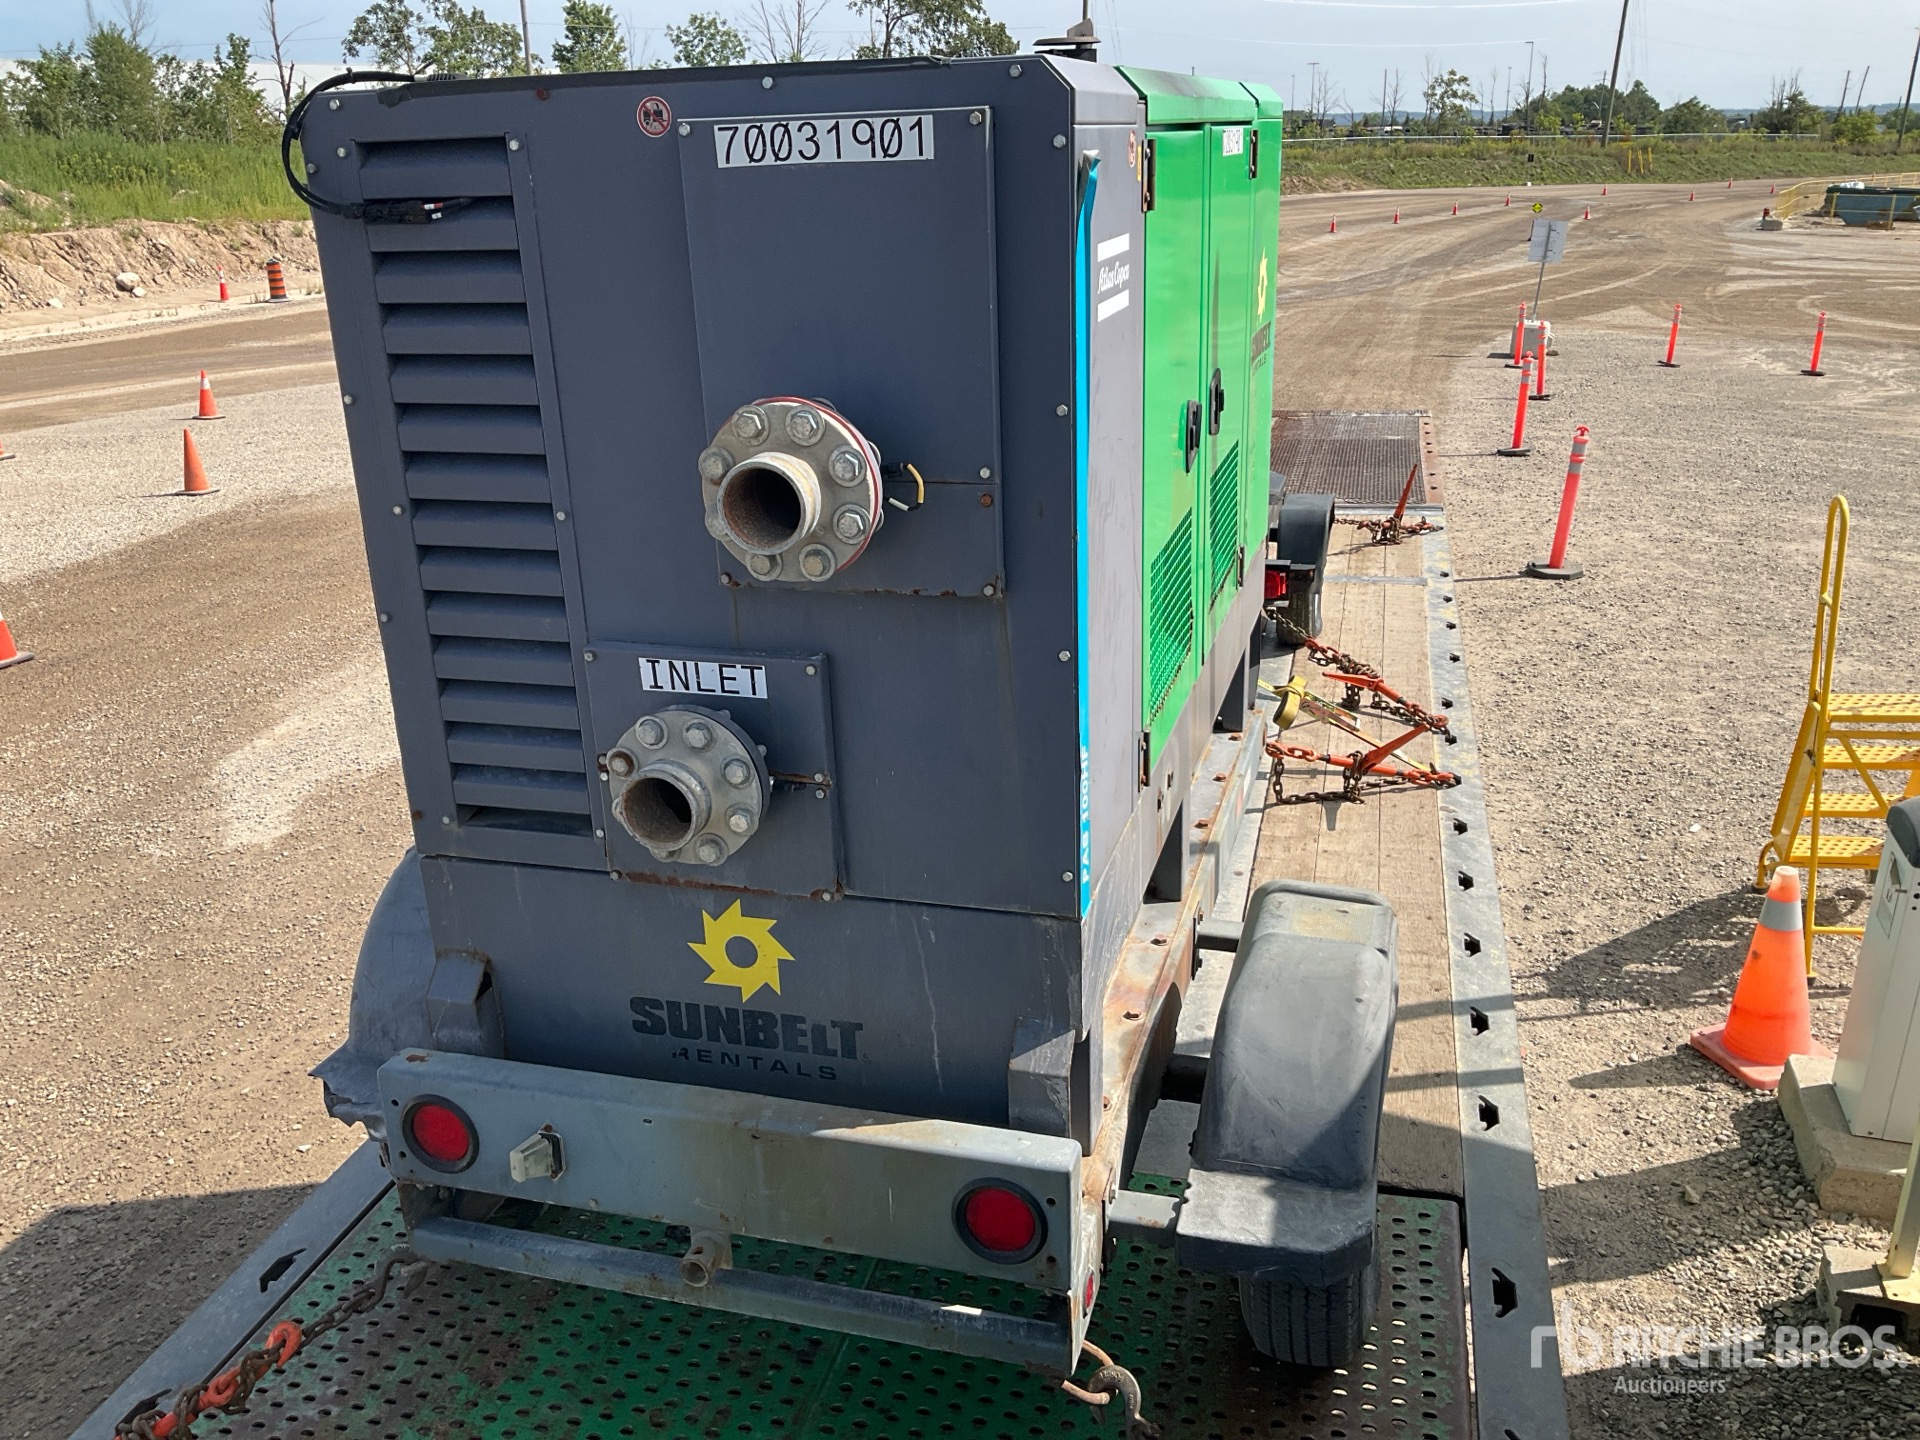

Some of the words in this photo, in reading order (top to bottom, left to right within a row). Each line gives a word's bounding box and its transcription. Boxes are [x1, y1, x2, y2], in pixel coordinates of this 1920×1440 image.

[717, 117, 924, 164] 70031901
[646, 658, 763, 696] INLET
[629, 996, 864, 1060] SUNBELT
[672, 1046, 837, 1081] RENTALS
